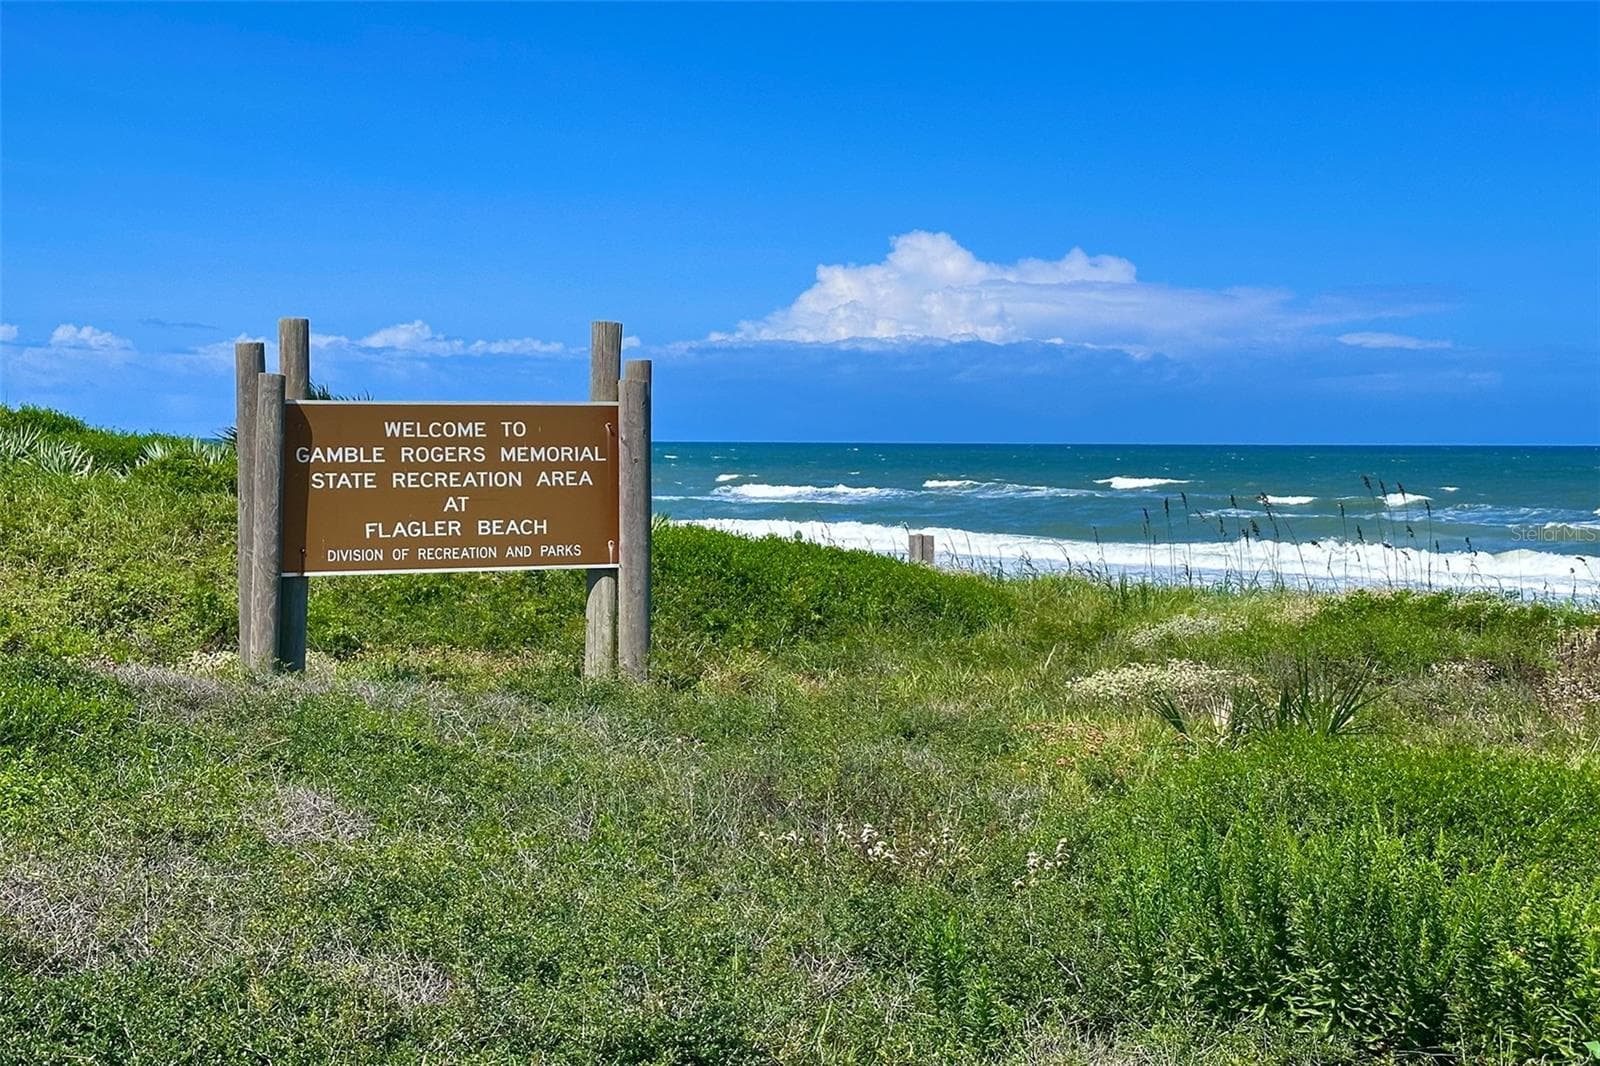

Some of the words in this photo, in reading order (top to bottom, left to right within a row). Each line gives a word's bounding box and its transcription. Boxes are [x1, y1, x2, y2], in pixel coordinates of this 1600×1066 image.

[384, 421, 486, 438] WELCOME
[501, 421, 526, 438] TO
[296, 447, 385, 463] GAMBLE
[401, 446, 486, 463] ROGERS
[501, 446, 606, 462] MEMORIAL
[311, 472, 376, 489] STATE
[392, 472, 522, 488] RECREATION
[536, 471, 593, 487] AREA
[443, 497, 469, 512] AT
[365, 521, 461, 539] FLAGLER
[478, 520, 547, 536] BEACH
[327, 549, 383, 562] DIVISION
[393, 548, 409, 561] OF
[418, 546, 496, 560] RECREATION
[506, 546, 532, 558] AND
[541, 544, 581, 557] PARKS
